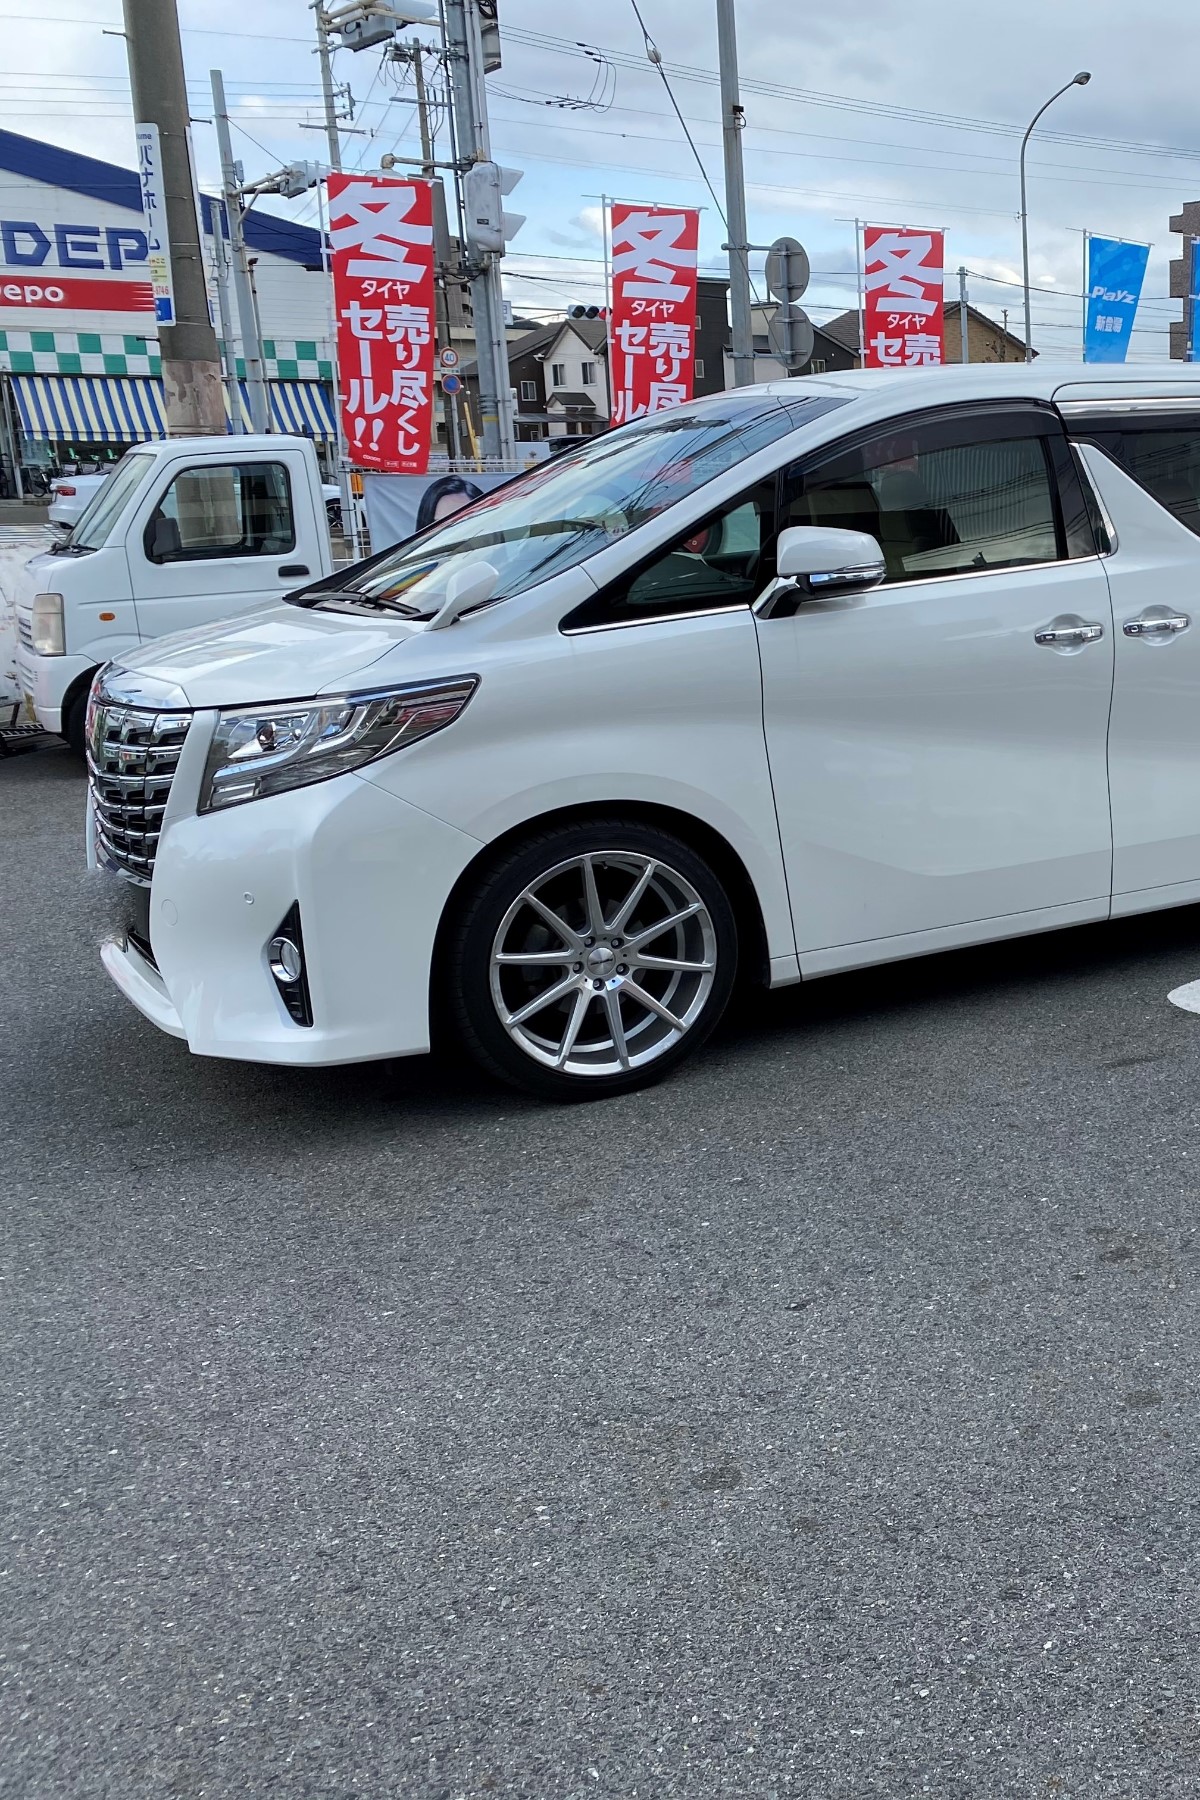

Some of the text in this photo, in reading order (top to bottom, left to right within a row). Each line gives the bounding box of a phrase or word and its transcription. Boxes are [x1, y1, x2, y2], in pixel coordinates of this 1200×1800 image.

[329, 182, 433, 283] 冬
[612, 212, 697, 302] 冬
[865, 233, 943, 316] 冬
[0, 284, 64, 304] epo
[361, 280, 410, 299] タイヤ
[631, 300, 674, 317] タイヤ
[887, 314, 926, 330] タイヤ
[1095, 315, 1124, 334] 新登場
[384, 304, 431, 456] 売り尽くし
